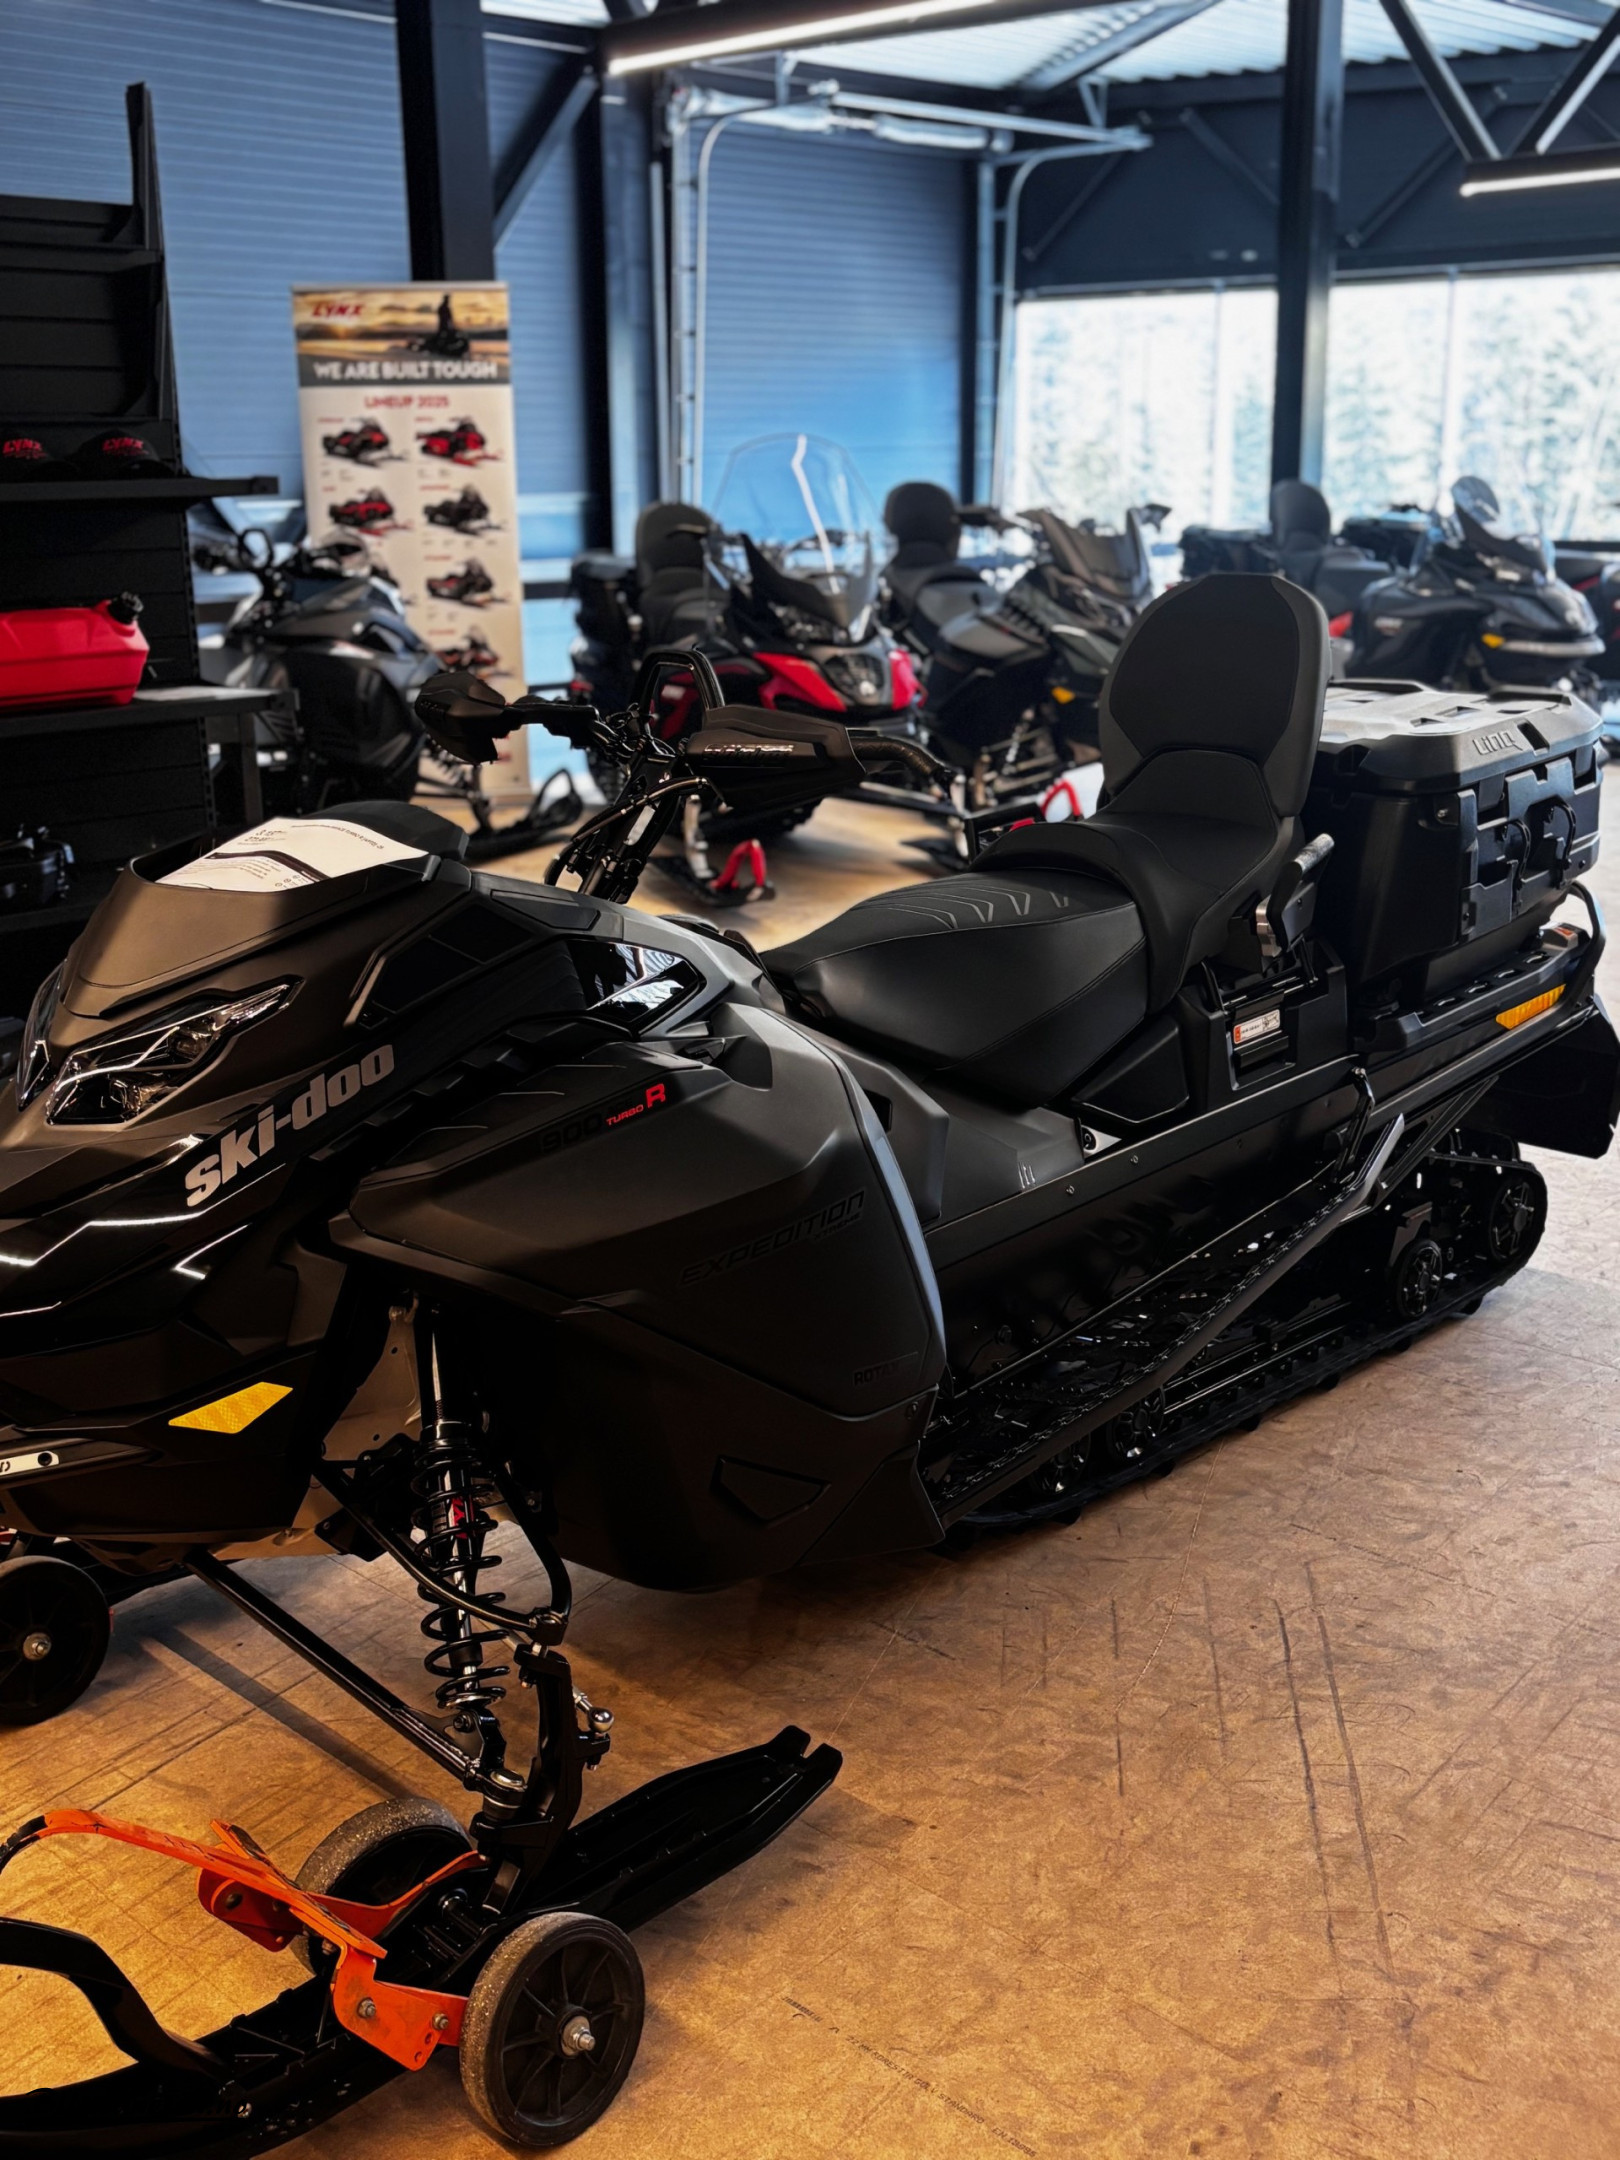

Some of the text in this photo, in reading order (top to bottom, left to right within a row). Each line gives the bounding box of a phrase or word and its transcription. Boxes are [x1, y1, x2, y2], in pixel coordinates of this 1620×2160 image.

[312, 302, 365, 318] LYNX
[313, 361, 498, 380] WE ARE BUILT TOUGH
[605, 1082, 667, 1127] TURBO R
[680, 1189, 866, 1285] EXPEDITION
[938, 2092, 985, 2125] STANDARD
